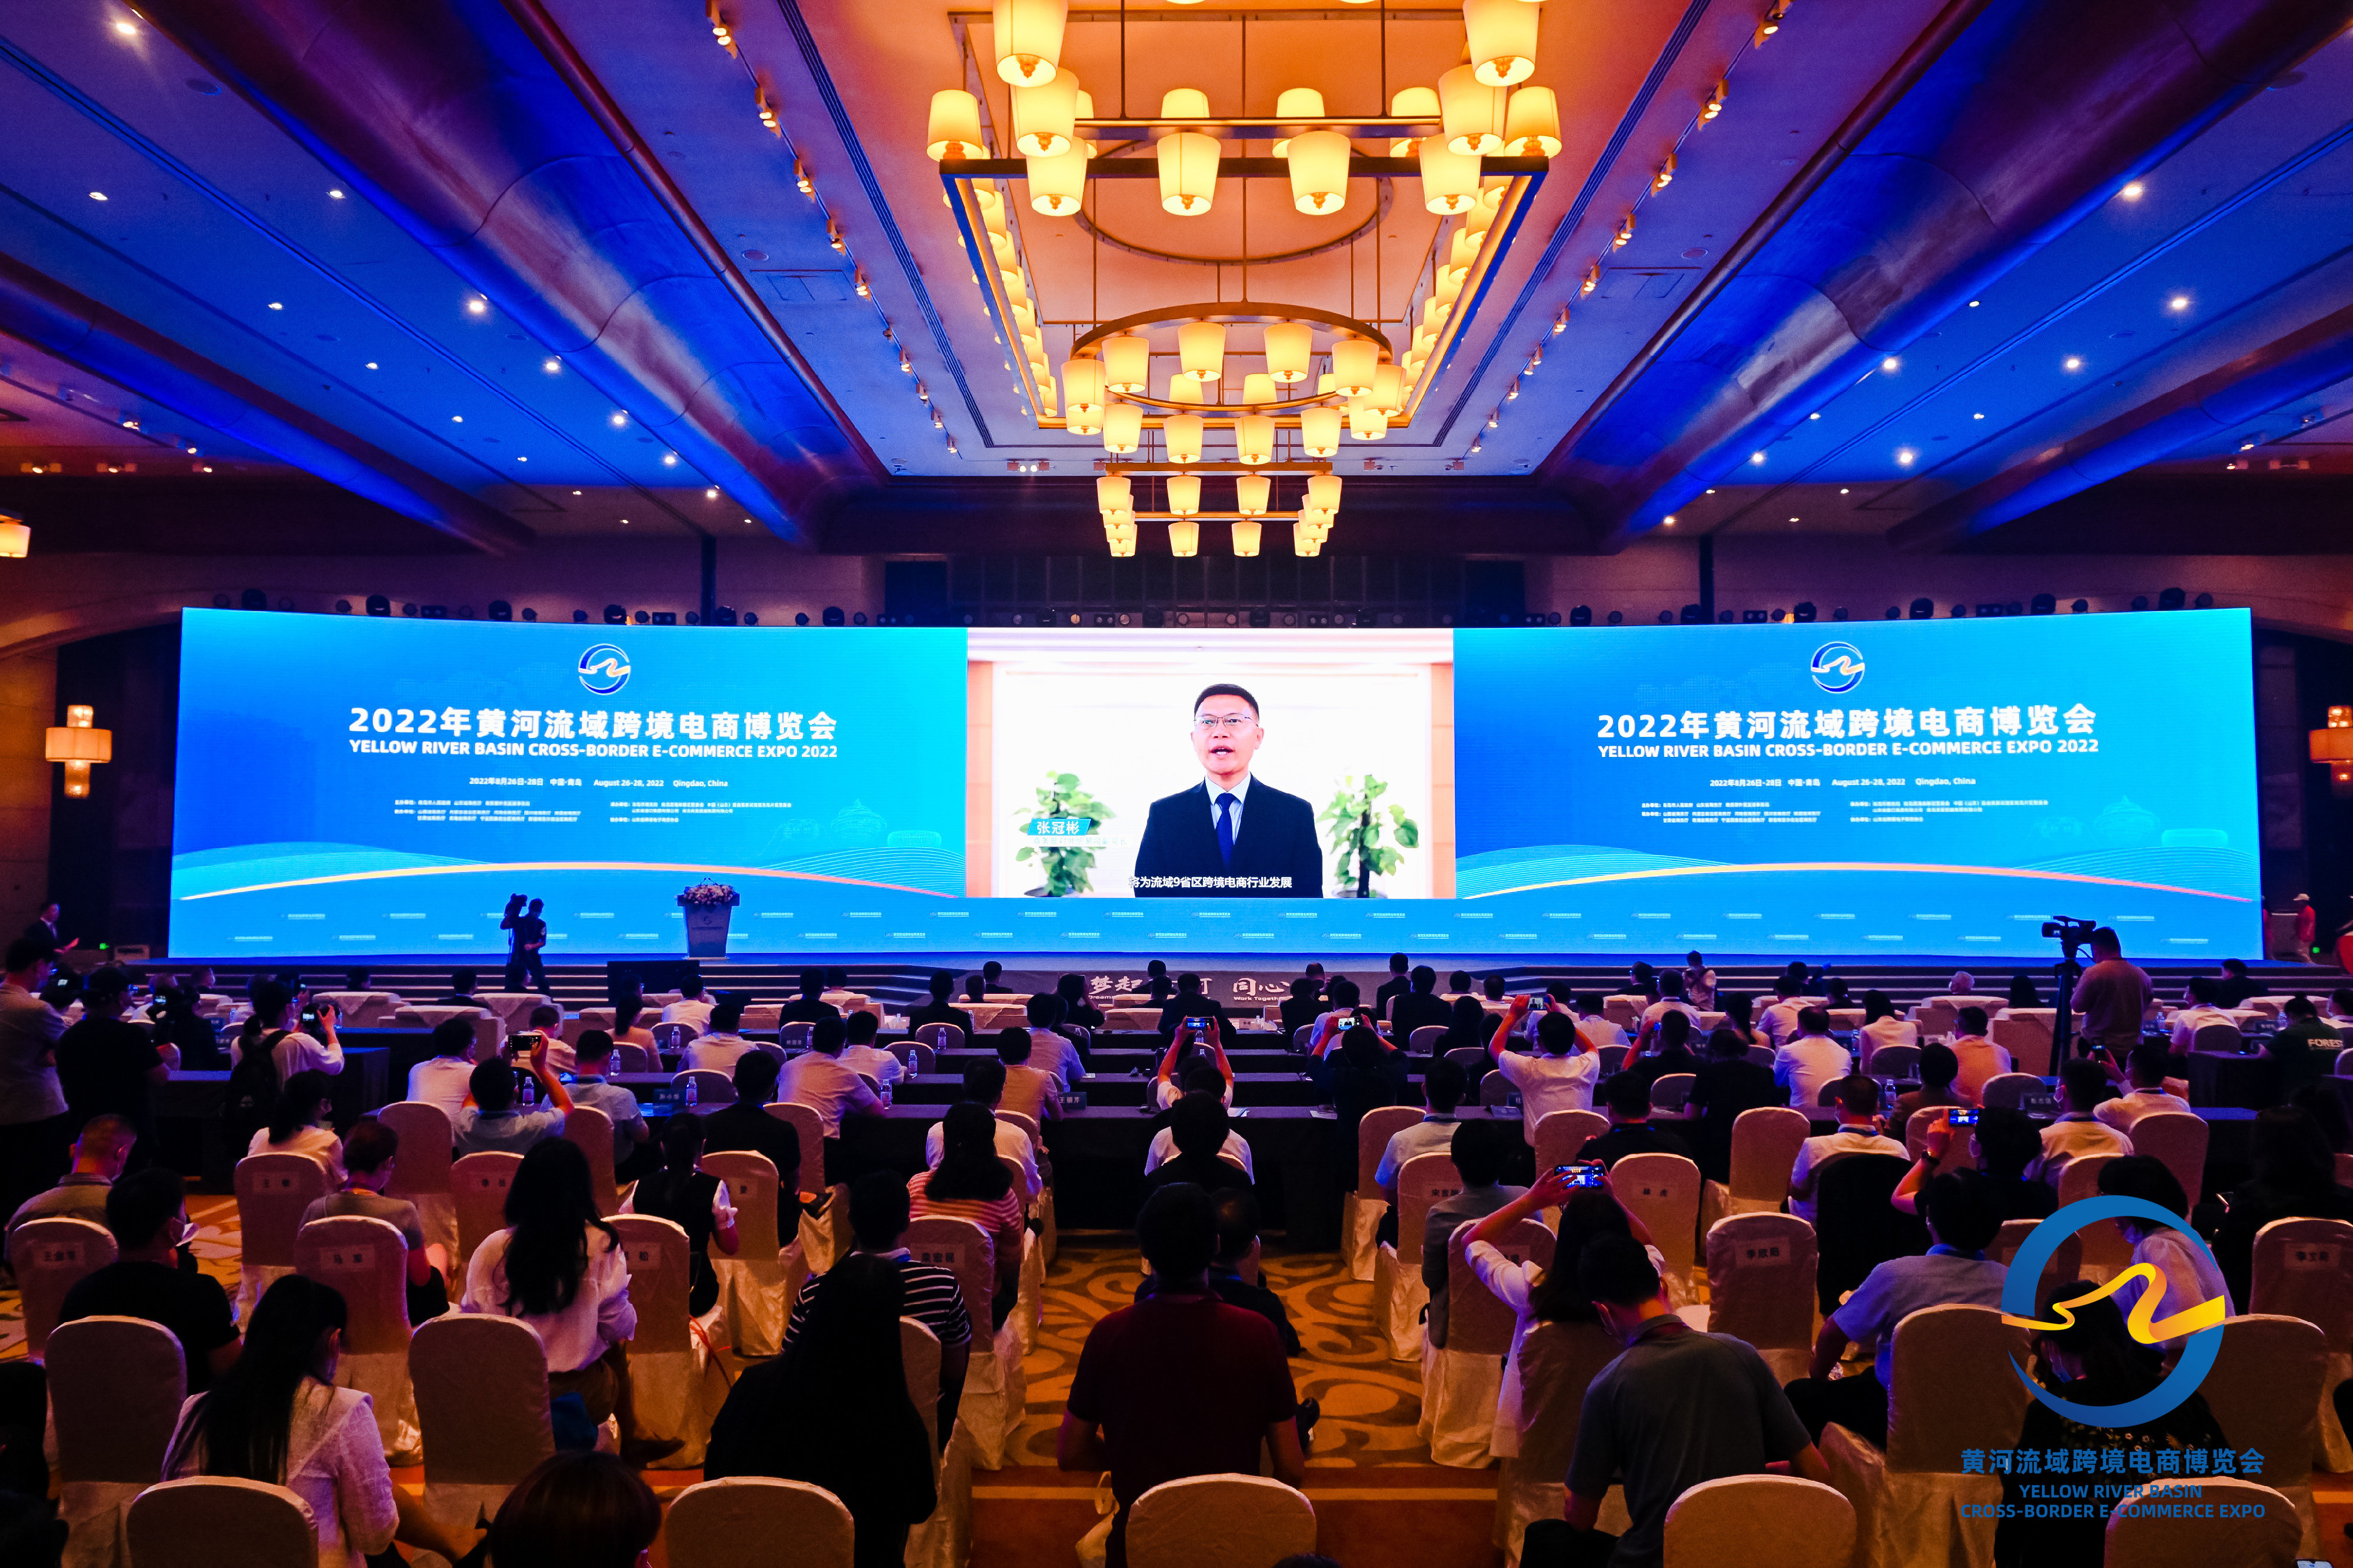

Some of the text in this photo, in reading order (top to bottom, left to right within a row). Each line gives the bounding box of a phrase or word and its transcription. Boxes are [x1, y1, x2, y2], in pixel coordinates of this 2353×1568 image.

[349, 706, 837, 740] 2022年黄河流域跨境电商博览会
[1597, 703, 2097, 739] 2022年黄河流域跨境电商博览会
[349, 739, 837, 758] YELLOW RIVER BASIN CROSS-BORDER E-COMMERCE EXPO 2022
[1598, 739, 2098, 758] YELLOW RIVER BASIN CROSS-BORDER E-COMMERCE EXPO 2022
[593, 779, 620, 788] August
[621, 779, 644, 788] 26-28,
[673, 779, 706, 788] Qingdao,
[1831, 778, 1859, 787] August
[1915, 778, 1951, 786] Qingdao,
[1952, 777, 1977, 785] China
[1036, 820, 1080, 835] 张冠彬
[1128, 876, 1292, 889] 将为流域9省区跨境电商行业发展
